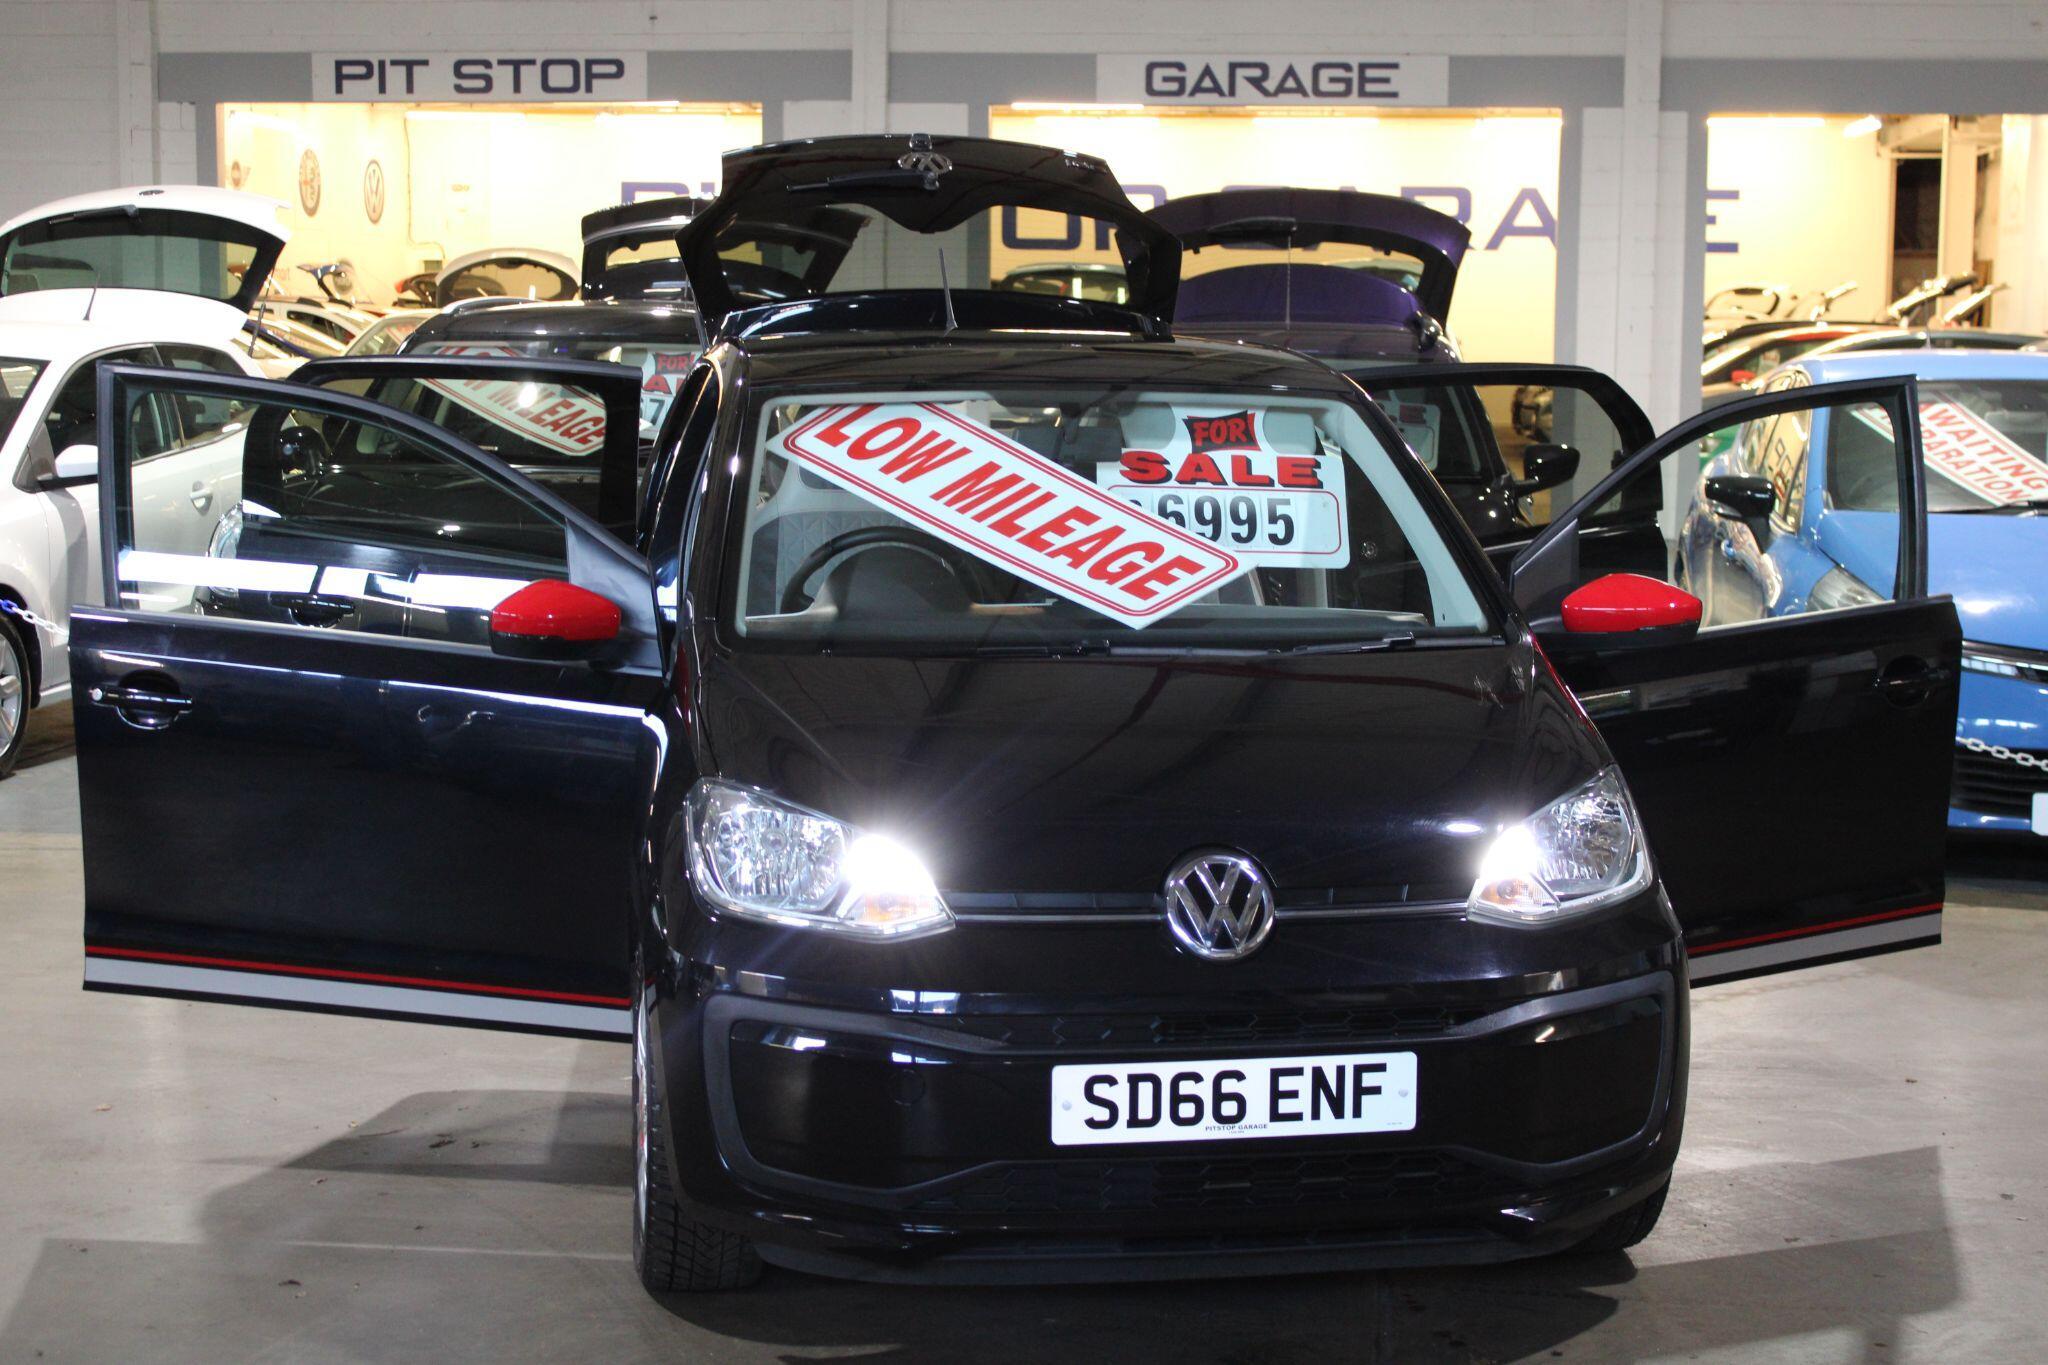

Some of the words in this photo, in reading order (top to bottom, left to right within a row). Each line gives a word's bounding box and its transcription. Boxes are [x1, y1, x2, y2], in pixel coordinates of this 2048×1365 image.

[334, 59, 429, 94] PIT
[453, 58, 625, 94] STOP
[1145, 61, 1400, 98] GARAGE
[1193, 418, 1247, 446] FOR
[1119, 450, 1324, 489] SALE
[814, 403, 972, 484] LOW
[928, 460, 1206, 600] MILEAGE
[1083, 1070, 1247, 1130] SD66
[1269, 1063, 1387, 1123] ENF
[1205, 1124, 1236, 1132] PITSTOP
